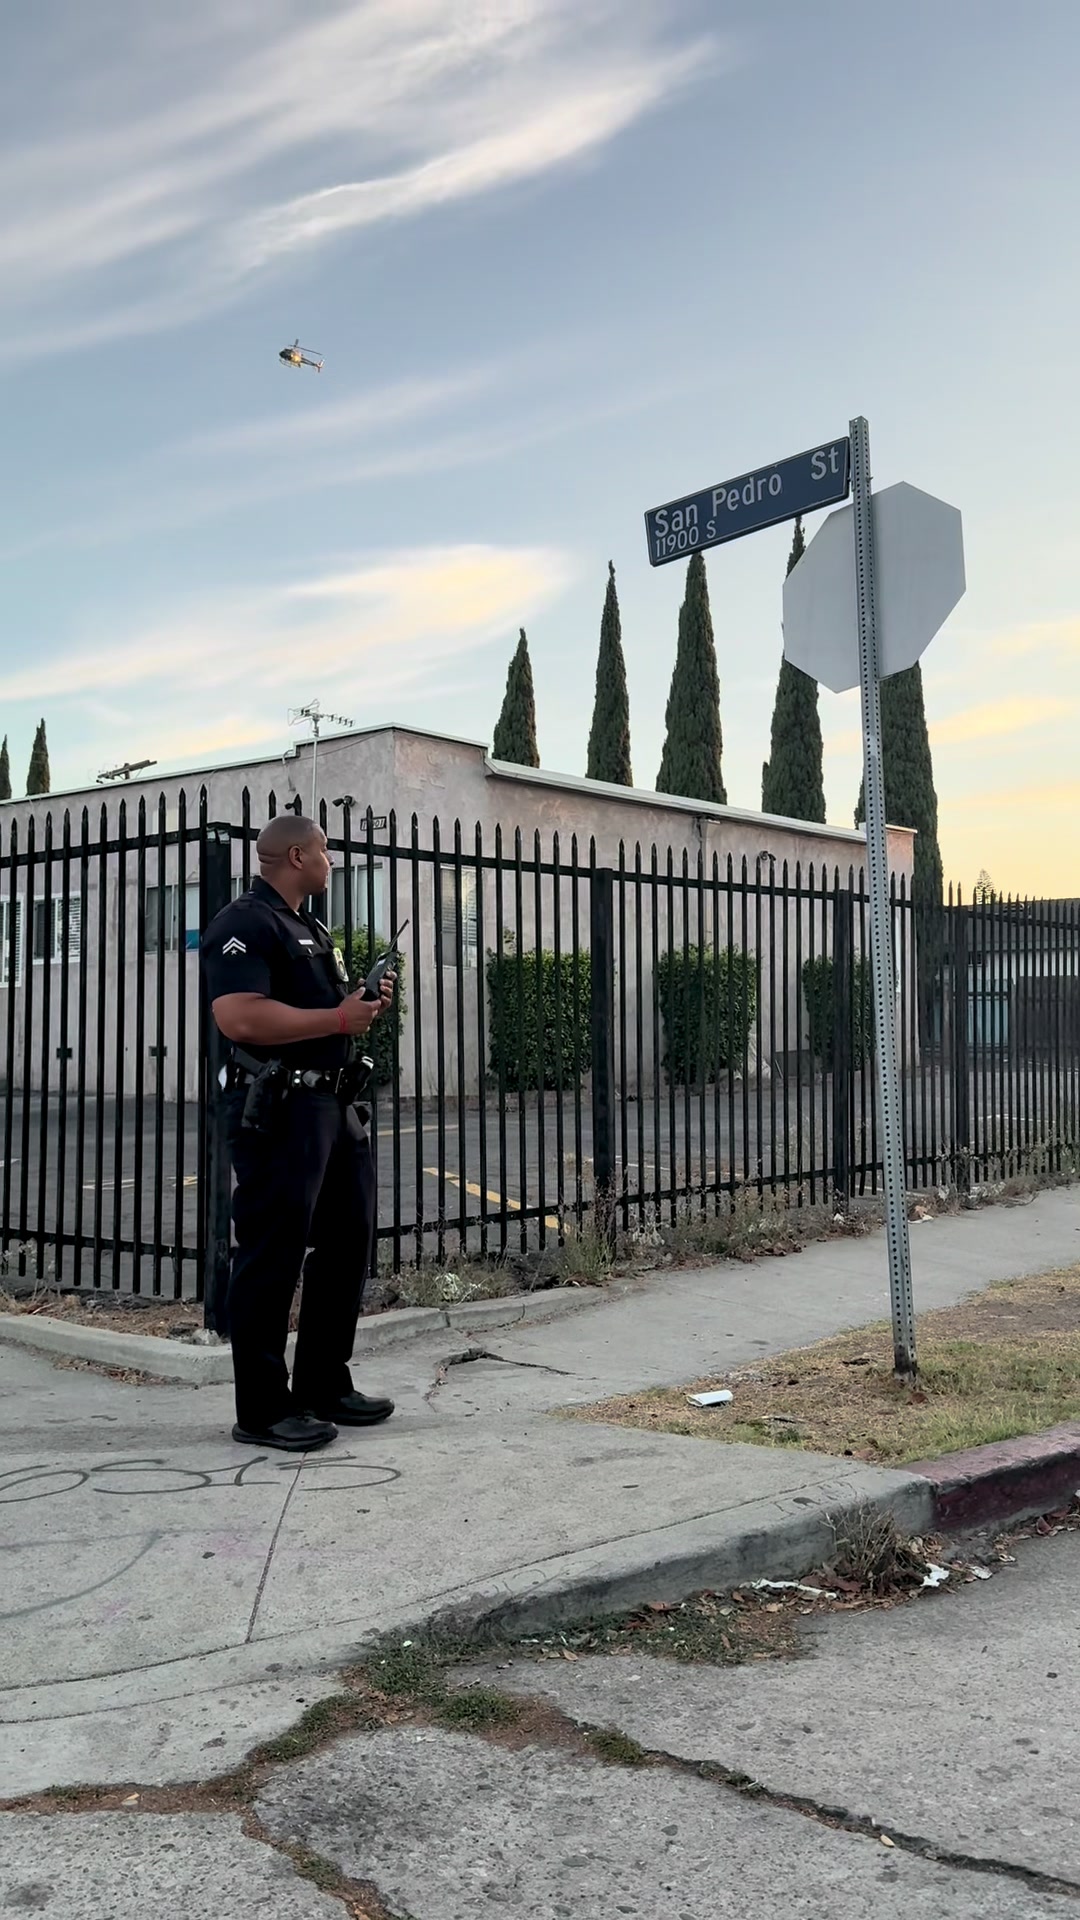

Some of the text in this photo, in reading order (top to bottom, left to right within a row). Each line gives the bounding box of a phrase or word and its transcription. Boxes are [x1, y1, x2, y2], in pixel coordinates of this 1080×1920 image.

[655, 447, 839, 538] San Pedro St
[656, 520, 717, 557] 11900 S
